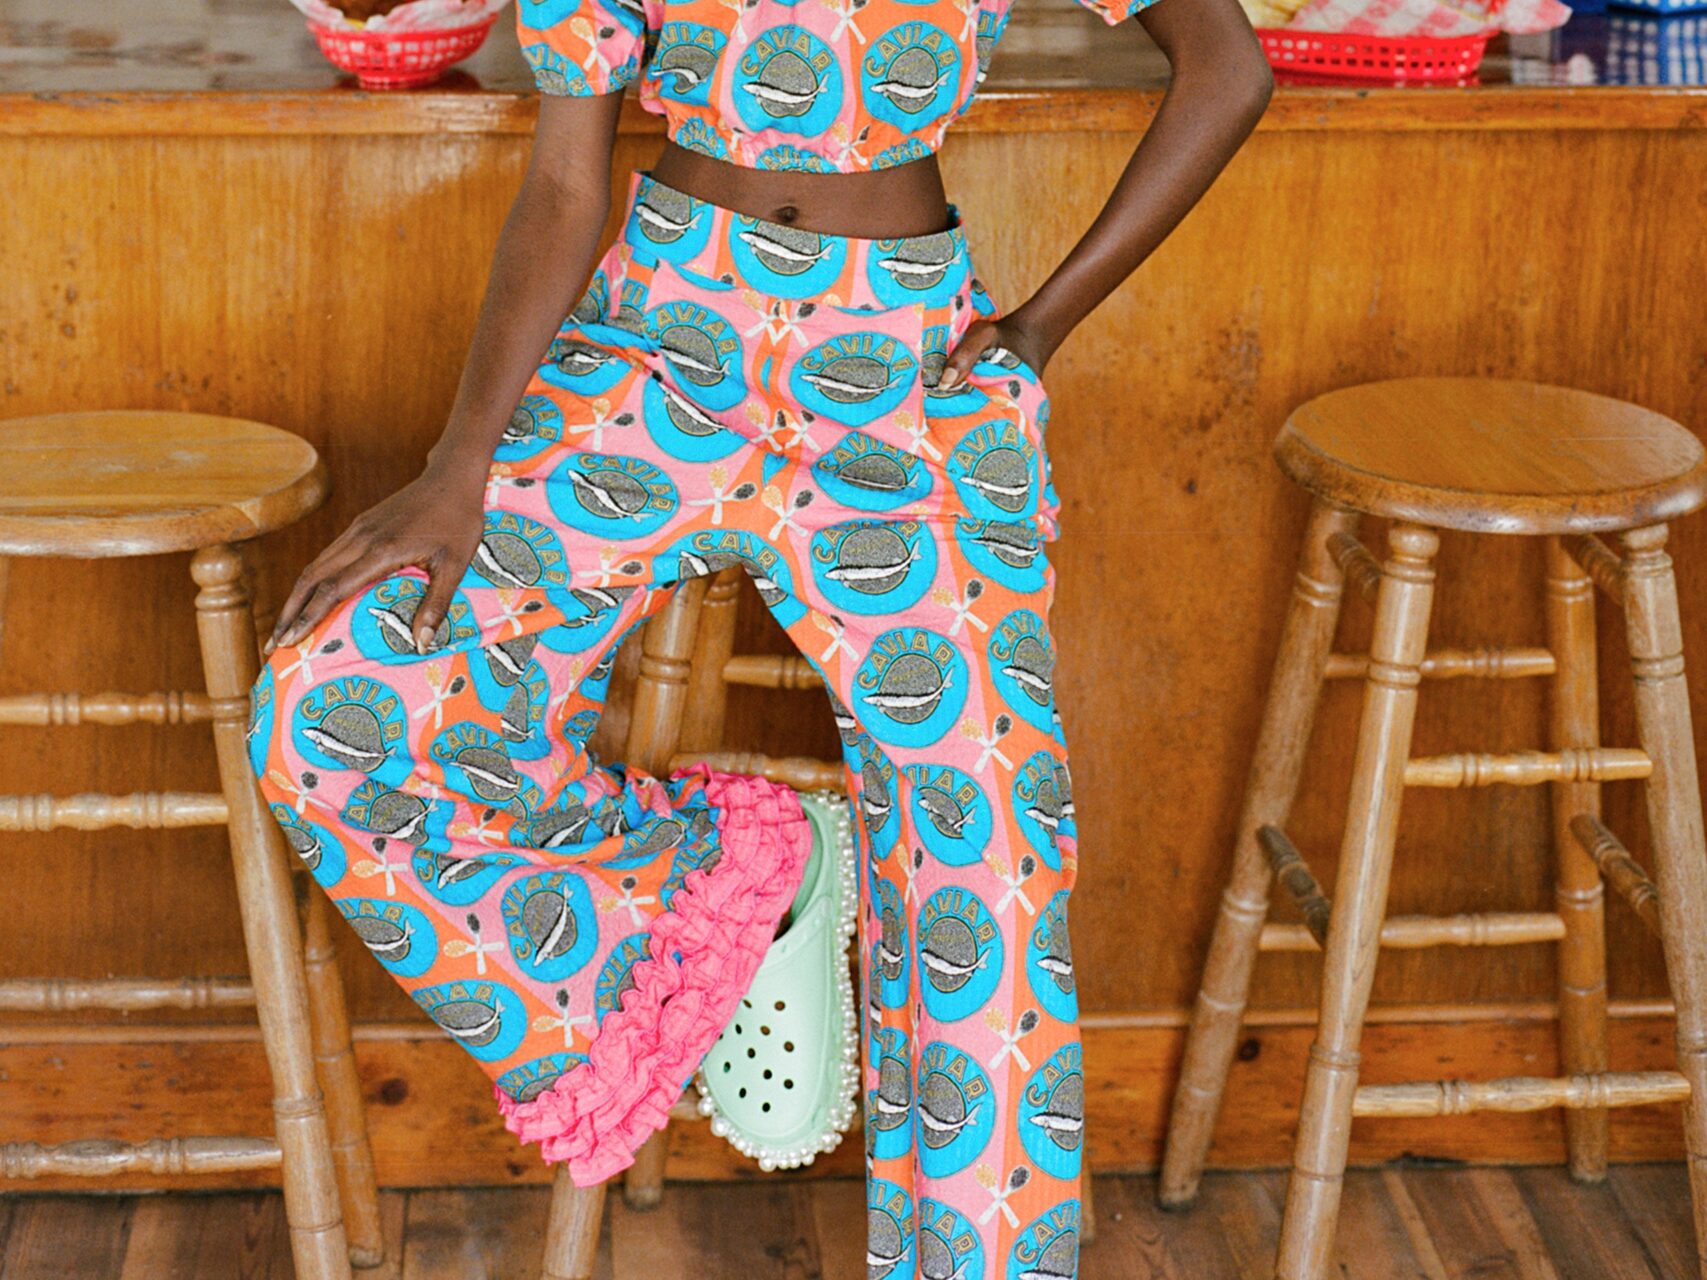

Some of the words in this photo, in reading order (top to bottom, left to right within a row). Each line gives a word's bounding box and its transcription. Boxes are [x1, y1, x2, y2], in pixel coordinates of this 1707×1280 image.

[740, 28, 833, 76] CAVIAR
[864, 24, 958, 79] CAVIAR
[642, 304, 738, 355] CAVIAR
[817, 431, 918, 472] CAVIAR
[578, 454, 675, 512] CAVIAR
[375, 578, 476, 640] CAAR
[857, 630, 955, 690] CAVIAR
[300, 678, 404, 742] CAVIAR
[433, 726, 508, 760] CAVIA
[1025, 1047, 1079, 1108] CAVI
[1014, 1204, 1079, 1265] CAVI
